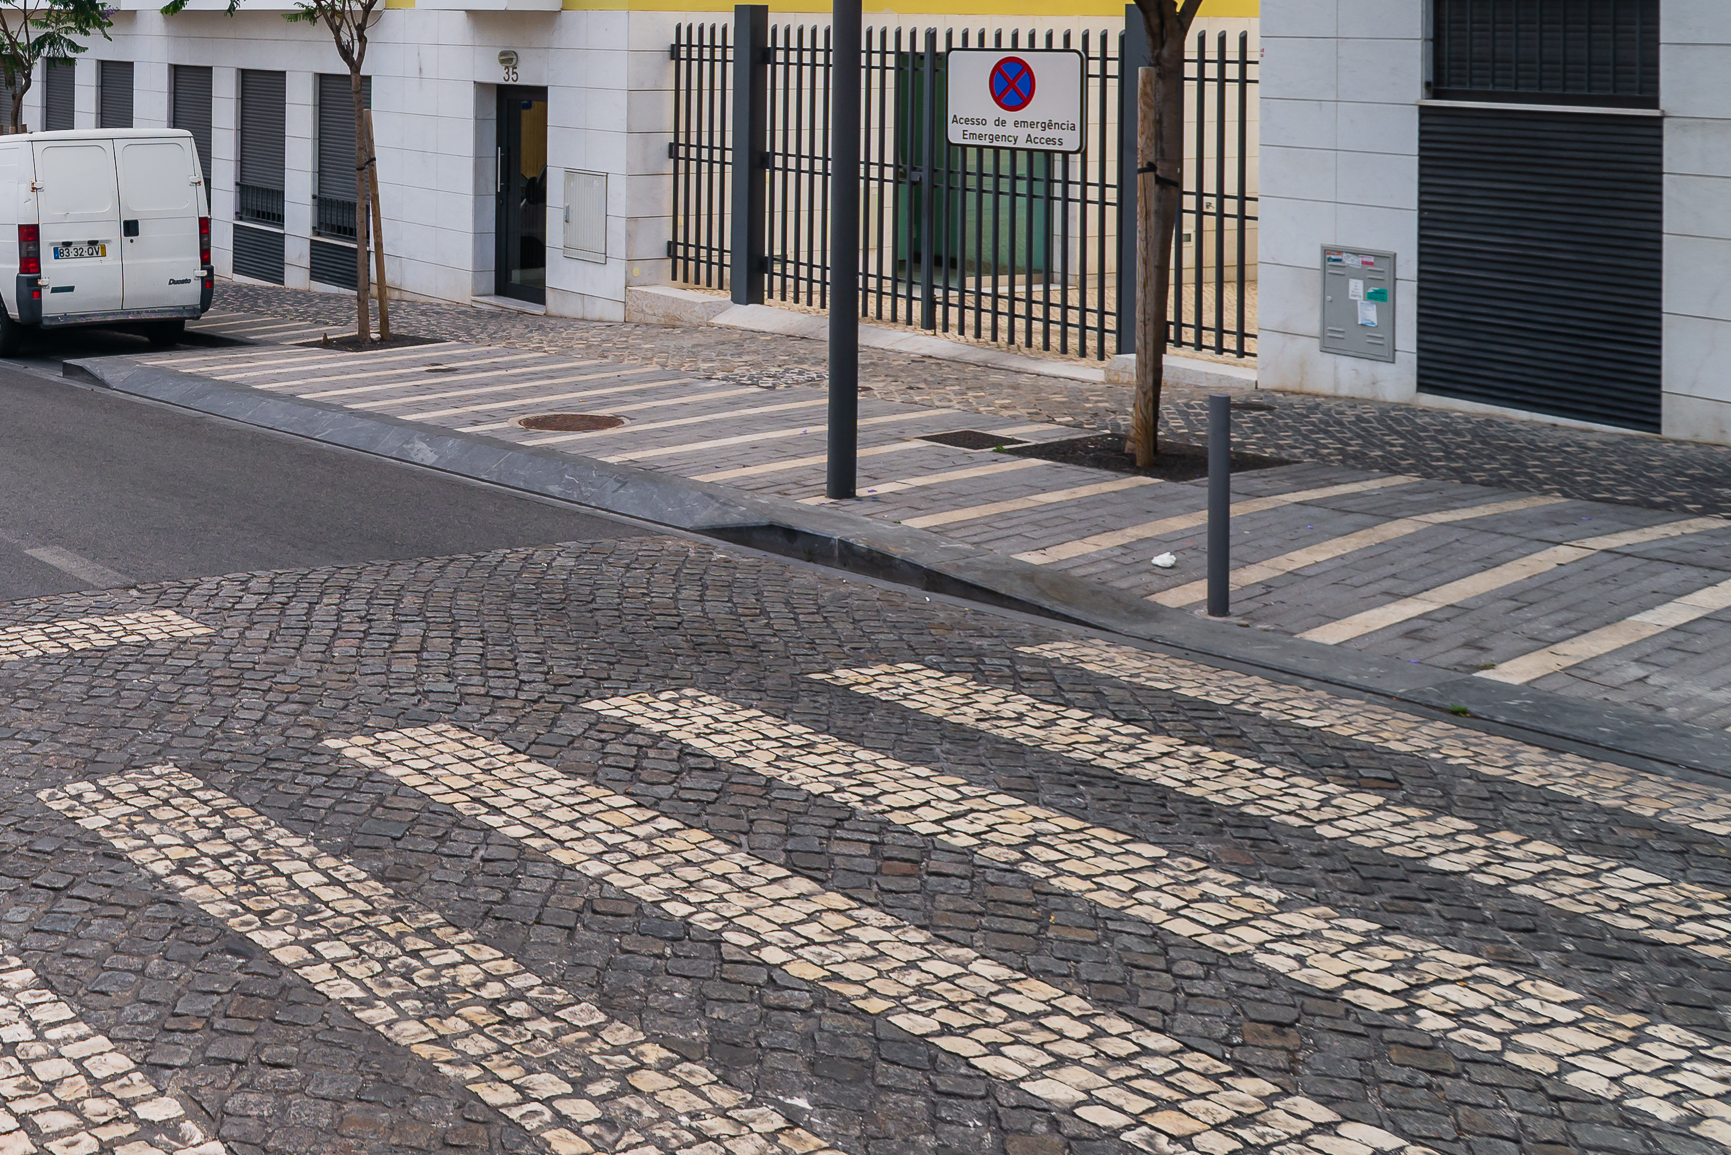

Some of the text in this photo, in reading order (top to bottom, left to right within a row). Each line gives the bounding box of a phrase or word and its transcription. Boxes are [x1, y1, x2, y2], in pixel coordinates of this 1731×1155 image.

[503, 66, 519, 83] 35
[951, 114, 1076, 132] Acesso de emergência
[962, 130, 1064, 146] Emergency Access
